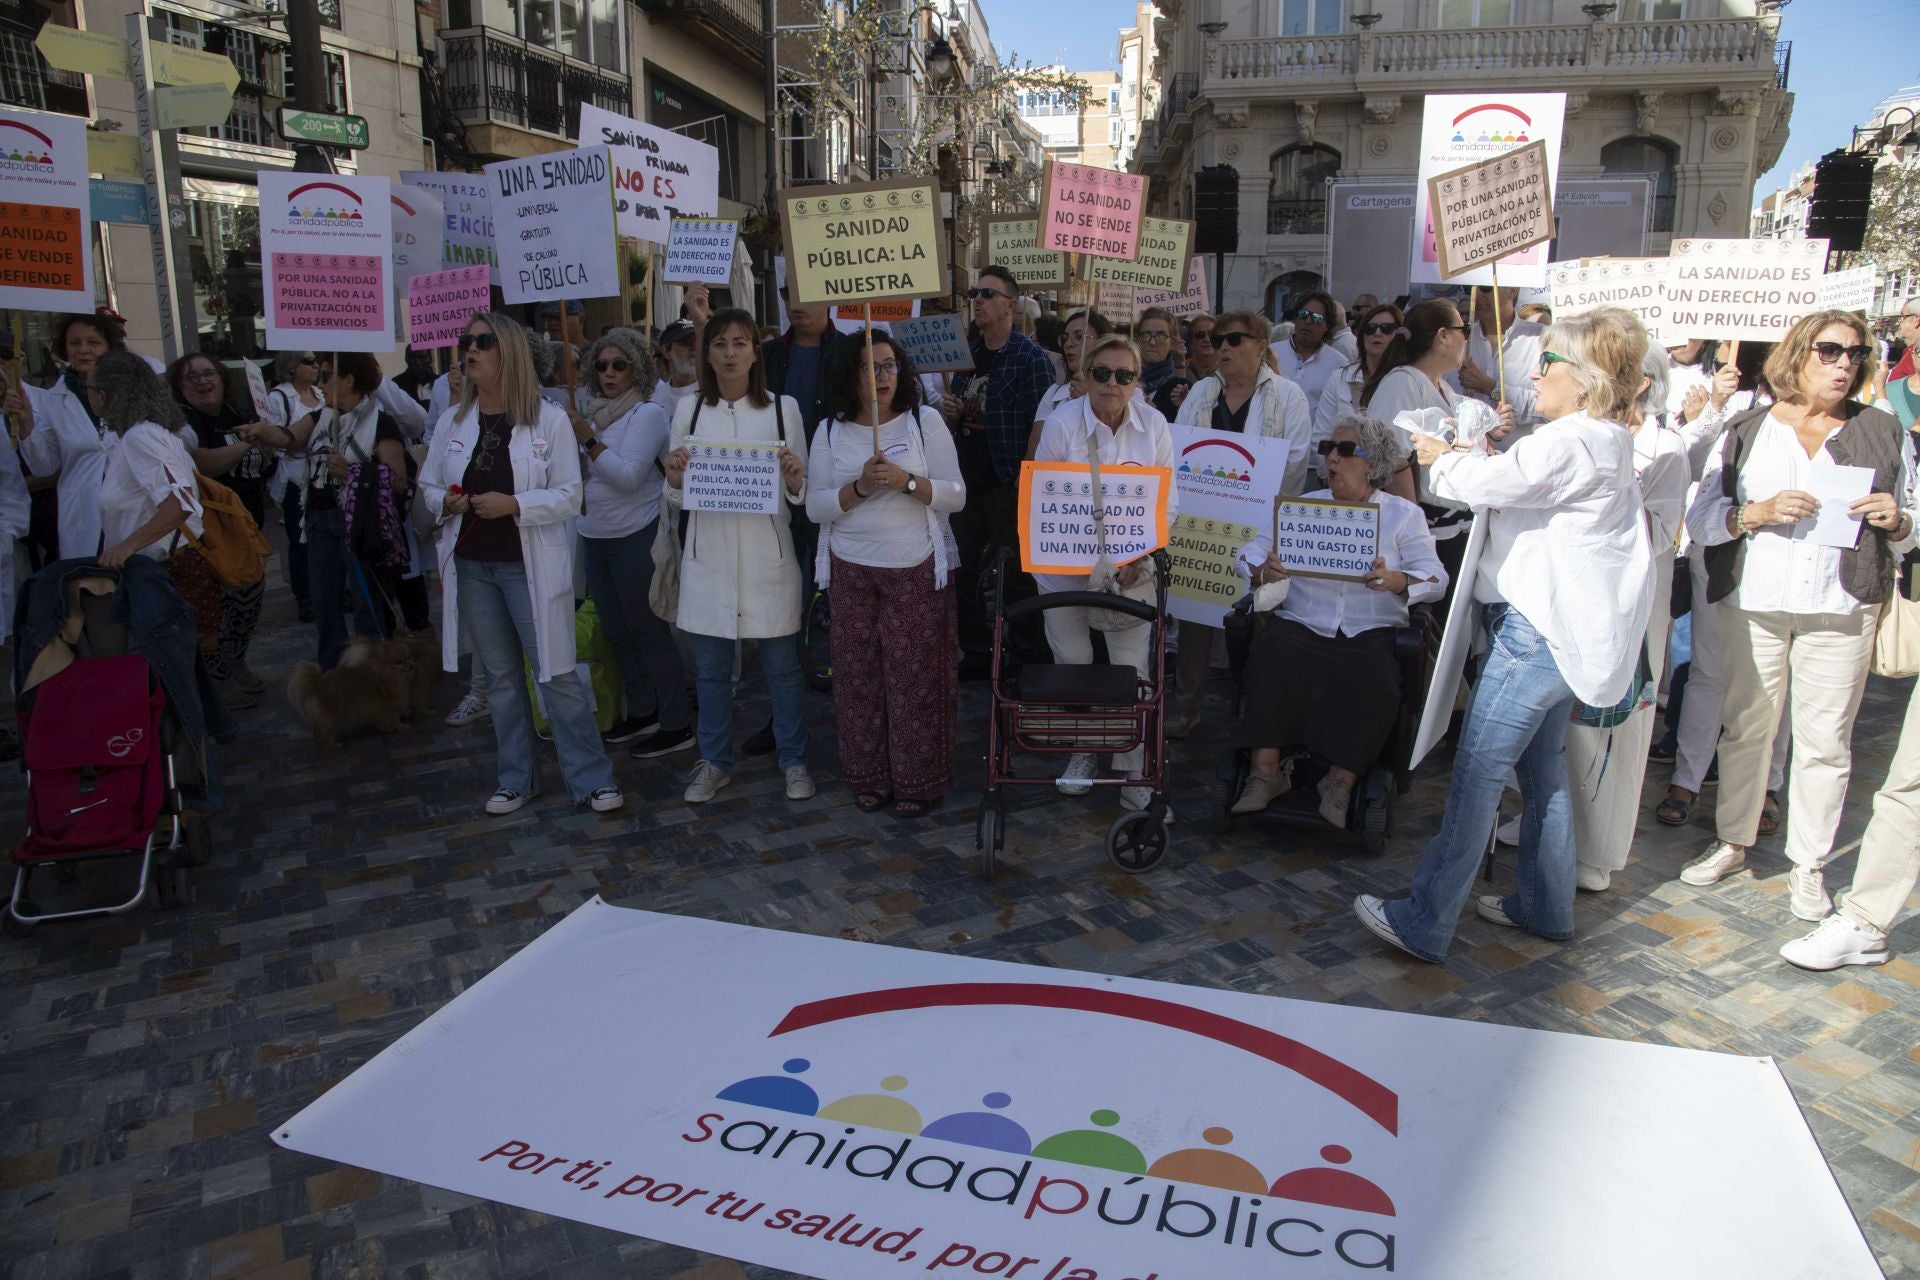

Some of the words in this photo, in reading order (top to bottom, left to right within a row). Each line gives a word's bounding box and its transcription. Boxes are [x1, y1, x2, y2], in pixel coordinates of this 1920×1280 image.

[302, 119, 322, 132] 200
[348, 136, 365, 145] DEA
[601, 127, 660, 154] SANIDAD
[645, 155, 690, 177] PRIVADA
[498, 164, 537, 197] UNA
[541, 152, 605, 190] SANIDAD
[615, 166, 645, 193] NO
[653, 176, 677, 200] ES
[1060, 188, 1075, 203] LA
[1078, 190, 1132, 211] SANIDAD
[1351, 195, 1412, 209] Cartagena
[1446, 200, 1469, 216] POR
[1471, 191, 1494, 207] UNA
[1495, 174, 1539, 198] SANIDAD
[1500, 199, 1516, 215] NO
[1517, 196, 1525, 206] A
[1527, 191, 1539, 205] LA
[1571, 191, 1600, 200] Edición
[825, 216, 909, 239] SANIDAD
[1055, 210, 1074, 225] NO
[1077, 214, 1093, 227] SE
[1096, 216, 1132, 233] VENDE
[1451, 210, 1528, 250] PRIVATIZACIÓN
[1529, 207, 1542, 222] DE
[0, 226, 68, 243] ANIDAD
[673, 237, 683, 245] LA
[684, 237, 719, 247] SANIDAD
[720, 238, 730, 247] ES
[1054, 233, 1069, 247] SE
[996, 240, 1009, 250] LA
[1010, 238, 1037, 249] SANI
[1464, 247, 1485, 262] LOS
[1486, 227, 1535, 254] SERVICIOS
[18, 249, 74, 265] VENDE
[525, 251, 534, 262] DE
[535, 248, 558, 261] CALIDAD
[668, 250, 680, 260] UN
[680, 251, 717, 261] DERECHO
[718, 252, 731, 261] NO
[807, 246, 895, 269] PÚBLICA:
[900, 243, 926, 261] LA
[995, 255, 1010, 266] NO
[1011, 255, 1023, 265] SE
[1024, 253, 1059, 264] VENDE
[1139, 256, 1178, 270] VENDE
[518, 261, 589, 293] PÚBLICA
[669, 265, 680, 273] UN
[682, 265, 725, 276] PRIVILEGIO
[1093, 267, 1108, 280] SE
[1111, 269, 1174, 287] DEFIENDE
[1678, 266, 1699, 280] LA
[1703, 267, 1785, 281] SANIDAD
[1791, 267, 1812, 281] ES
[278, 274, 301, 283] POR
[303, 274, 327, 284] UNA
[329, 275, 377, 286] SANIDAD
[824, 272, 915, 295] NUESTRA
[281, 286, 330, 299] PÚBLICA.
[333, 290, 350, 299] NO
[352, 291, 360, 300] A
[362, 290, 376, 300] LA
[410, 296, 424, 308] LA
[425, 289, 470, 306] SANIDAD
[472, 286, 489, 298] NO
[1136, 295, 1152, 304] NO
[1154, 293, 1166, 302] SE
[1168, 287, 1203, 300] VENDE
[1555, 294, 1574, 307] LA
[1578, 285, 1653, 306] SANIDAD
[1666, 289, 1692, 303] UN
[1698, 290, 1782, 305] DERECHO
[1787, 291, 1817, 305] NO
[1823, 290, 1860, 302] DERECHO
[1861, 286, 1874, 295] NO
[280, 301, 361, 314] PRIVATIZACIÓN
[364, 305, 378, 314] DE
[292, 317, 313, 327] LOS
[314, 318, 368, 328] SERVICIOS
[411, 314, 424, 326] ES
[425, 312, 440, 324] UN
[1672, 311, 1699, 325] UN
[1703, 313, 1803, 328] PRIVILEGIO
[411, 331, 435, 344] UNA
[900, 330, 957, 349] DERIVACIÓN
[689, 462, 709, 471] POR
[710, 463, 731, 472] UNA
[733, 465, 775, 474] SANIDAD
[691, 472, 733, 484] PÚBLICA.
[735, 477, 749, 486] NO
[751, 478, 758, 486] A
[760, 479, 772, 487] LA
[1175, 471, 1250, 491] sanidadpública
[689, 487, 759, 499] PRIVATIZACIÓN
[761, 491, 773, 499] DE
[698, 500, 716, 508] LOS
[717, 501, 764, 511] SERVICIOS
[1041, 502, 1058, 514] LA
[1061, 503, 1122, 517] SANIAD
[1125, 506, 1145, 517] NO
[1041, 522, 1055, 534] ES
[1059, 523, 1079, 534] UN
[1130, 525, 1145, 536] ES
[1280, 521, 1295, 532] LA
[1297, 523, 1352, 537] SANIDAD
[1355, 527, 1375, 539] NO
[1040, 541, 1070, 554] UNA
[1168, 535, 1227, 556] SANIDAD
[1280, 537, 1293, 548] ES
[1296, 539, 1314, 550] UN
[1317, 541, 1357, 554] GASTO
[1360, 545, 1375, 555] ES
[1279, 553, 1305, 565] UNA
[1308, 556, 1374, 571] INVERSIÓN
[682, 1112, 1397, 1274] sanidadpública
[478, 1140, 569, 1176] Por
[562, 1160, 613, 1191] ti,
[604, 1174, 710, 1208] por
[704, 1191, 767, 1223] tu
[763, 1207, 926, 1264] salud,
[926, 1243, 1040, 1280] por
